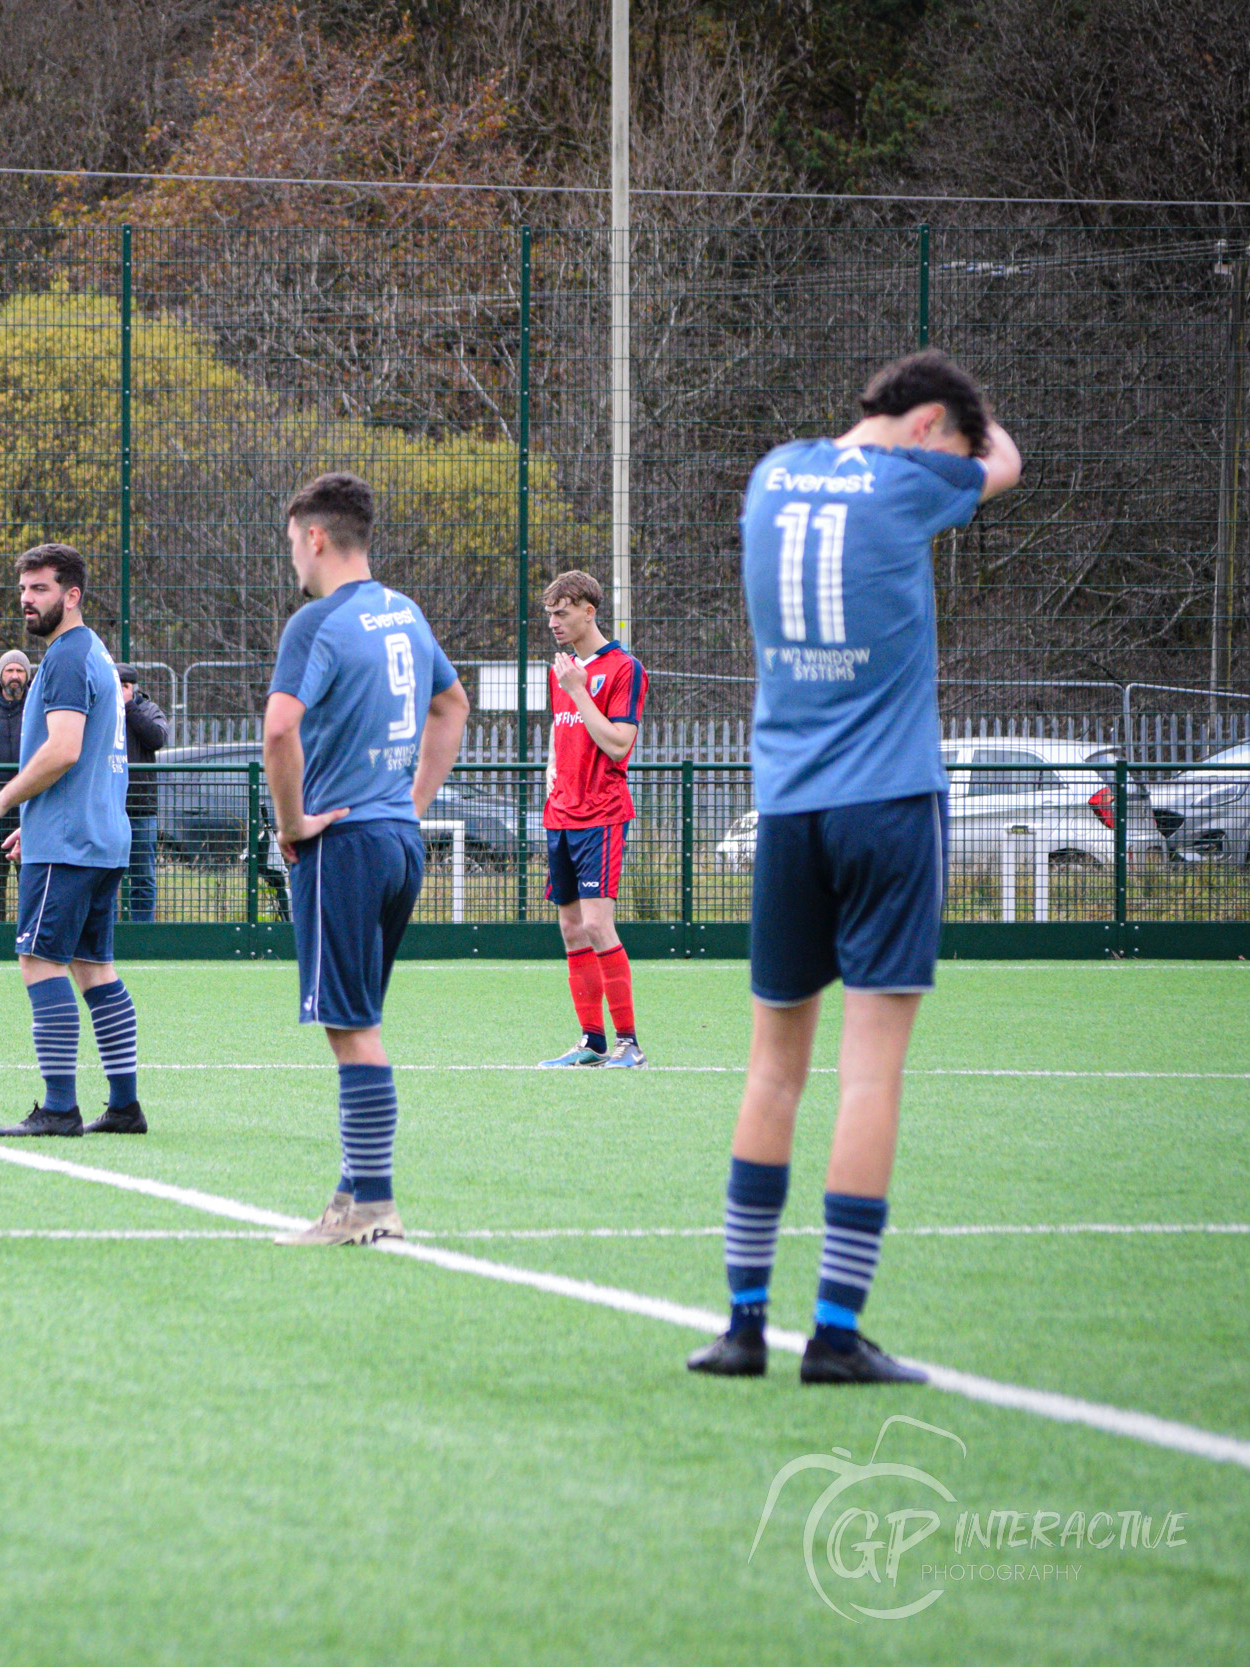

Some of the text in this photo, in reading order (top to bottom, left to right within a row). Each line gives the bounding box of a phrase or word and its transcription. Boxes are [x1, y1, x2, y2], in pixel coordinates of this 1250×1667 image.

[765, 467, 876, 493] Everest
[774, 502, 849, 644] 11
[359, 606, 417, 632] Everest
[804, 646, 870, 665] WINDOW
[793, 663, 856, 681] SYSTEMS
[384, 632, 417, 741] 9
[562, 711, 584, 727] FlyF
